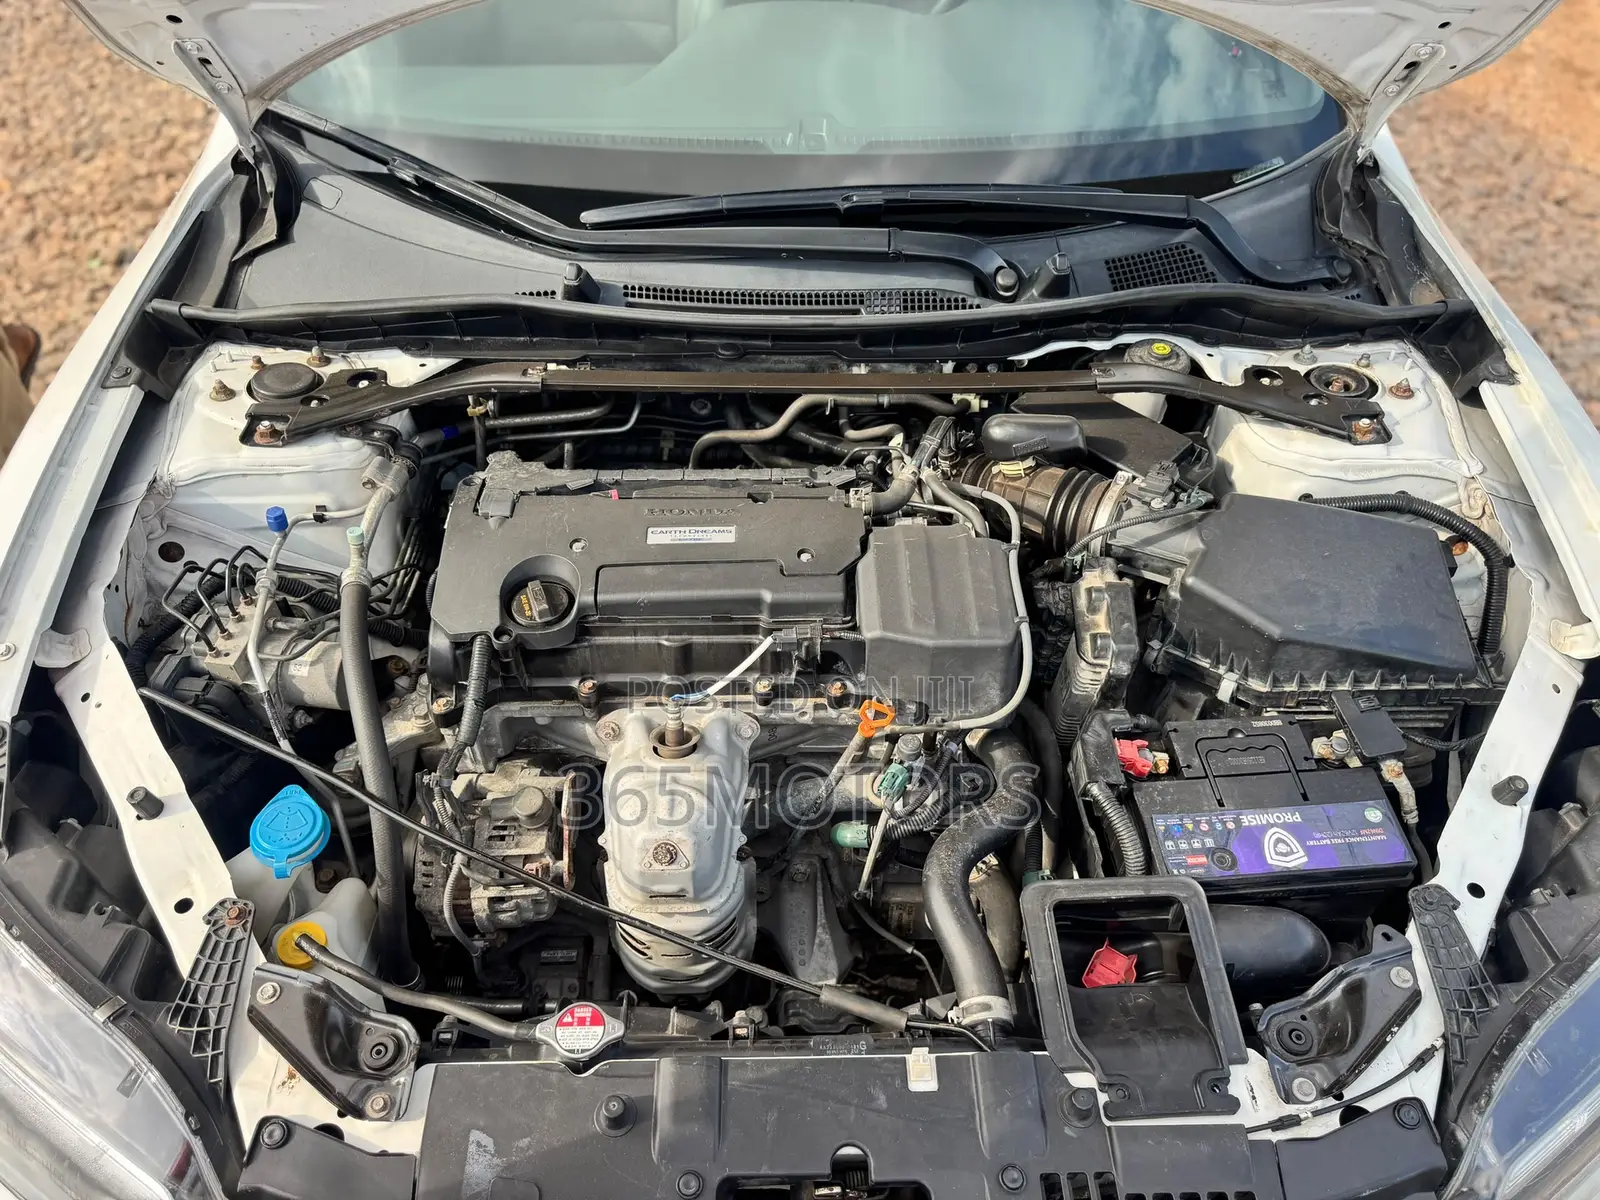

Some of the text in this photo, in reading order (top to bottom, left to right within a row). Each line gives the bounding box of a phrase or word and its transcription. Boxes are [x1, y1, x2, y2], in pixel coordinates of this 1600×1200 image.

[644, 508, 735, 516] HONDA
[1239, 811, 1302, 826] PROMISE
[1306, 838, 1332, 846] BATTERY
[1345, 835, 1387, 843] MAINTENANCE
